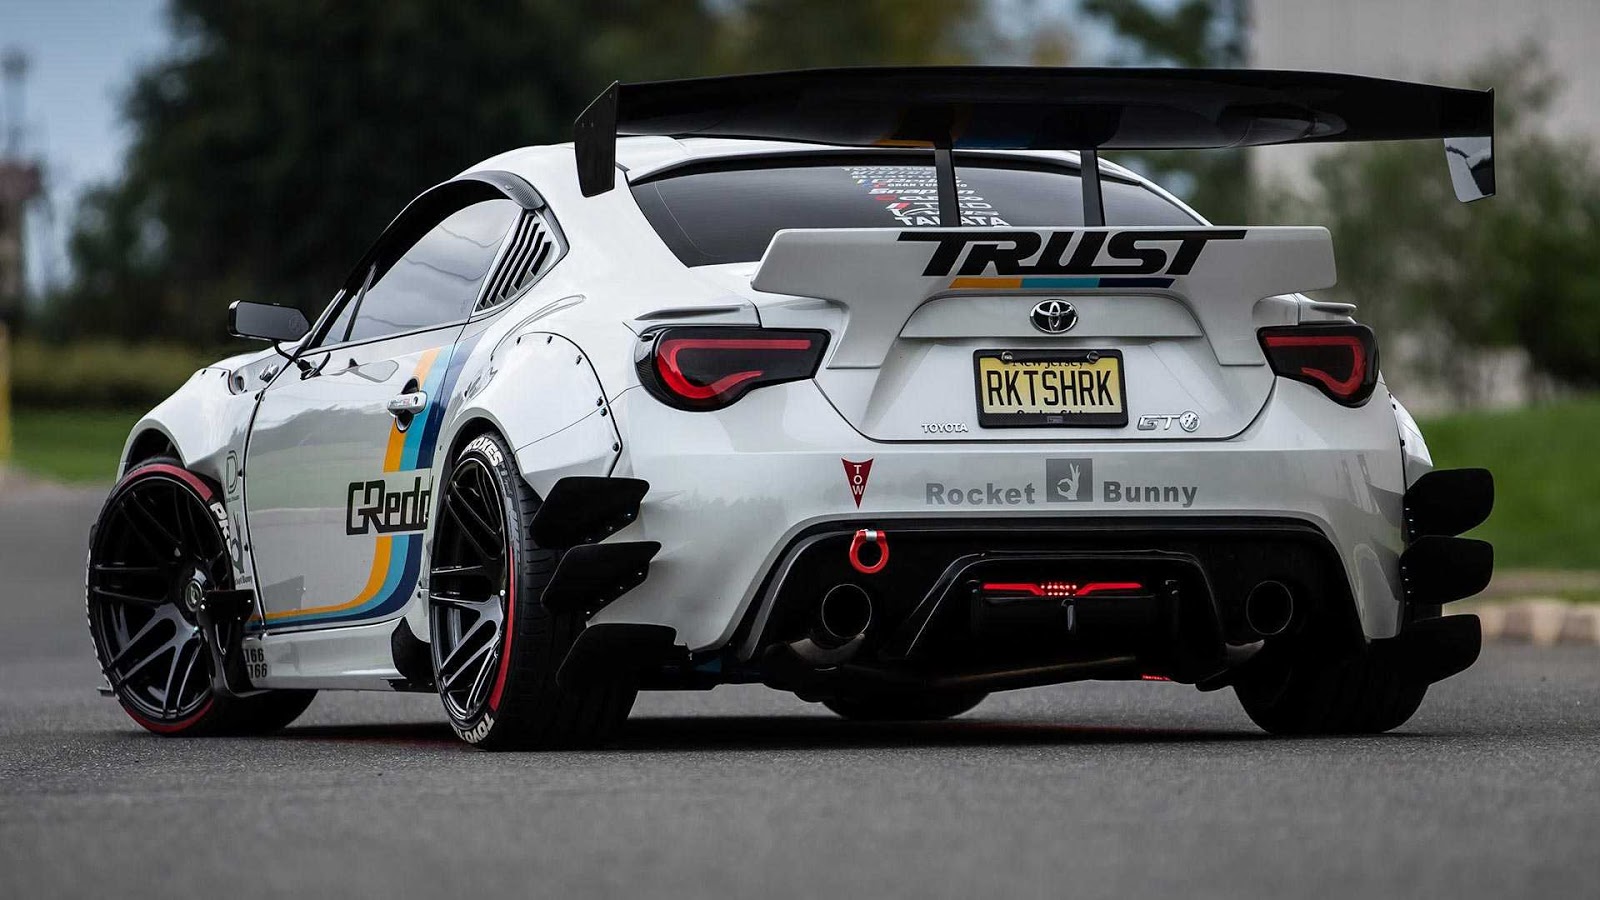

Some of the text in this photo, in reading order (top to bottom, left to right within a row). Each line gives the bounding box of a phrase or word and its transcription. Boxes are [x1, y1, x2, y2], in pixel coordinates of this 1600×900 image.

[897, 229, 1248, 277] TRUST
[986, 370, 1115, 406] RKTSHRK
[921, 423, 969, 433] TOYOTA
[852, 464, 865, 495] TOW
[925, 481, 1198, 508] Rocket Bunny
[346, 475, 435, 536] GRedd
